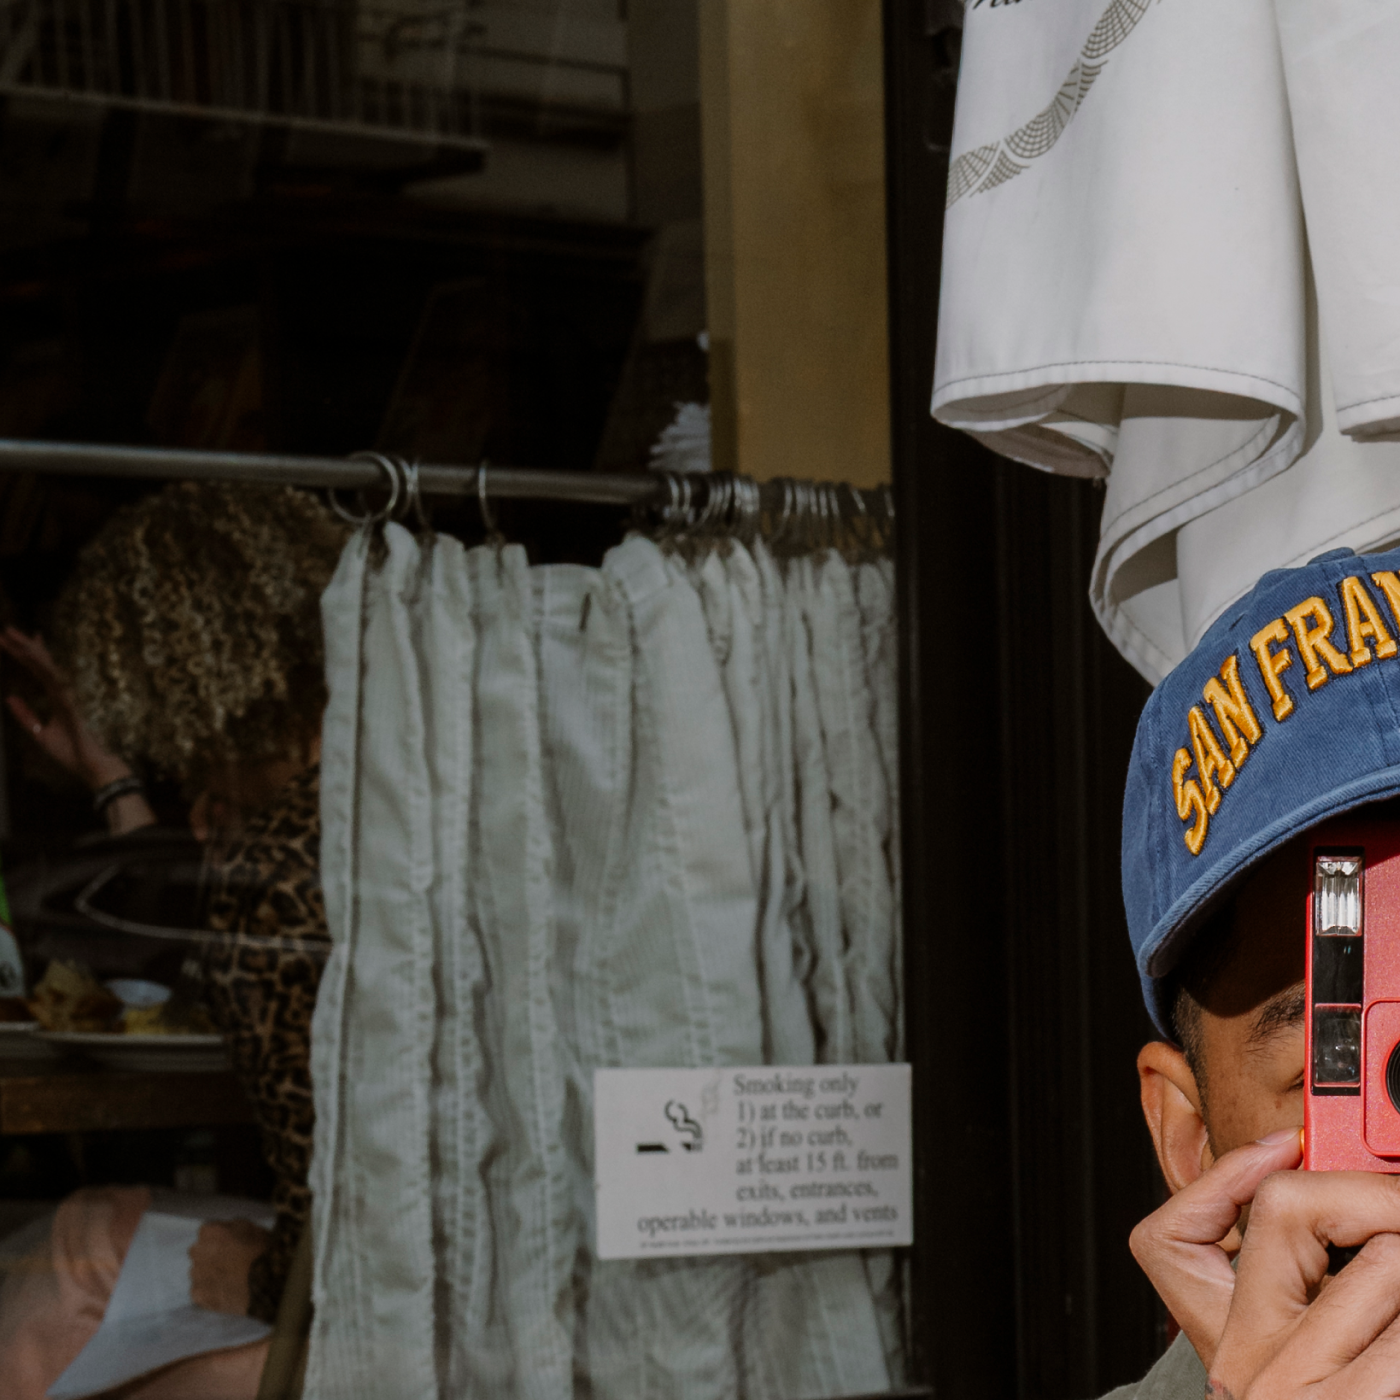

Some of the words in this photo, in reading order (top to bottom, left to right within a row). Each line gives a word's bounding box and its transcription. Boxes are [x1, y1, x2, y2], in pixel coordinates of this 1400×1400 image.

[1171, 655, 1264, 857] SAN
[734, 1073, 815, 1098] Smoking
[819, 1071, 859, 1096] only
[738, 1103, 755, 1122] 1)
[760, 1103, 776, 1120] at
[780, 1101, 810, 1120] the
[814, 1099, 860, 1121] curb,
[864, 1101, 883, 1119] or
[737, 1127, 755, 1148] 2)
[760, 1125, 776, 1148] if
[780, 1131, 801, 1146] no
[807, 1125, 853, 1146] curb,
[736, 1157, 753, 1174] at
[759, 1153, 800, 1173] least
[807, 1153, 827, 1172] 15
[856, 1151, 899, 1170] from
[736, 1179, 786, 1201] exits,
[789, 1182, 879, 1200] entrances,
[637, 1209, 716, 1237] operable
[724, 1207, 808, 1228] windows,
[815, 1205, 846, 1224] and
[852, 1206, 897, 1223] vents
